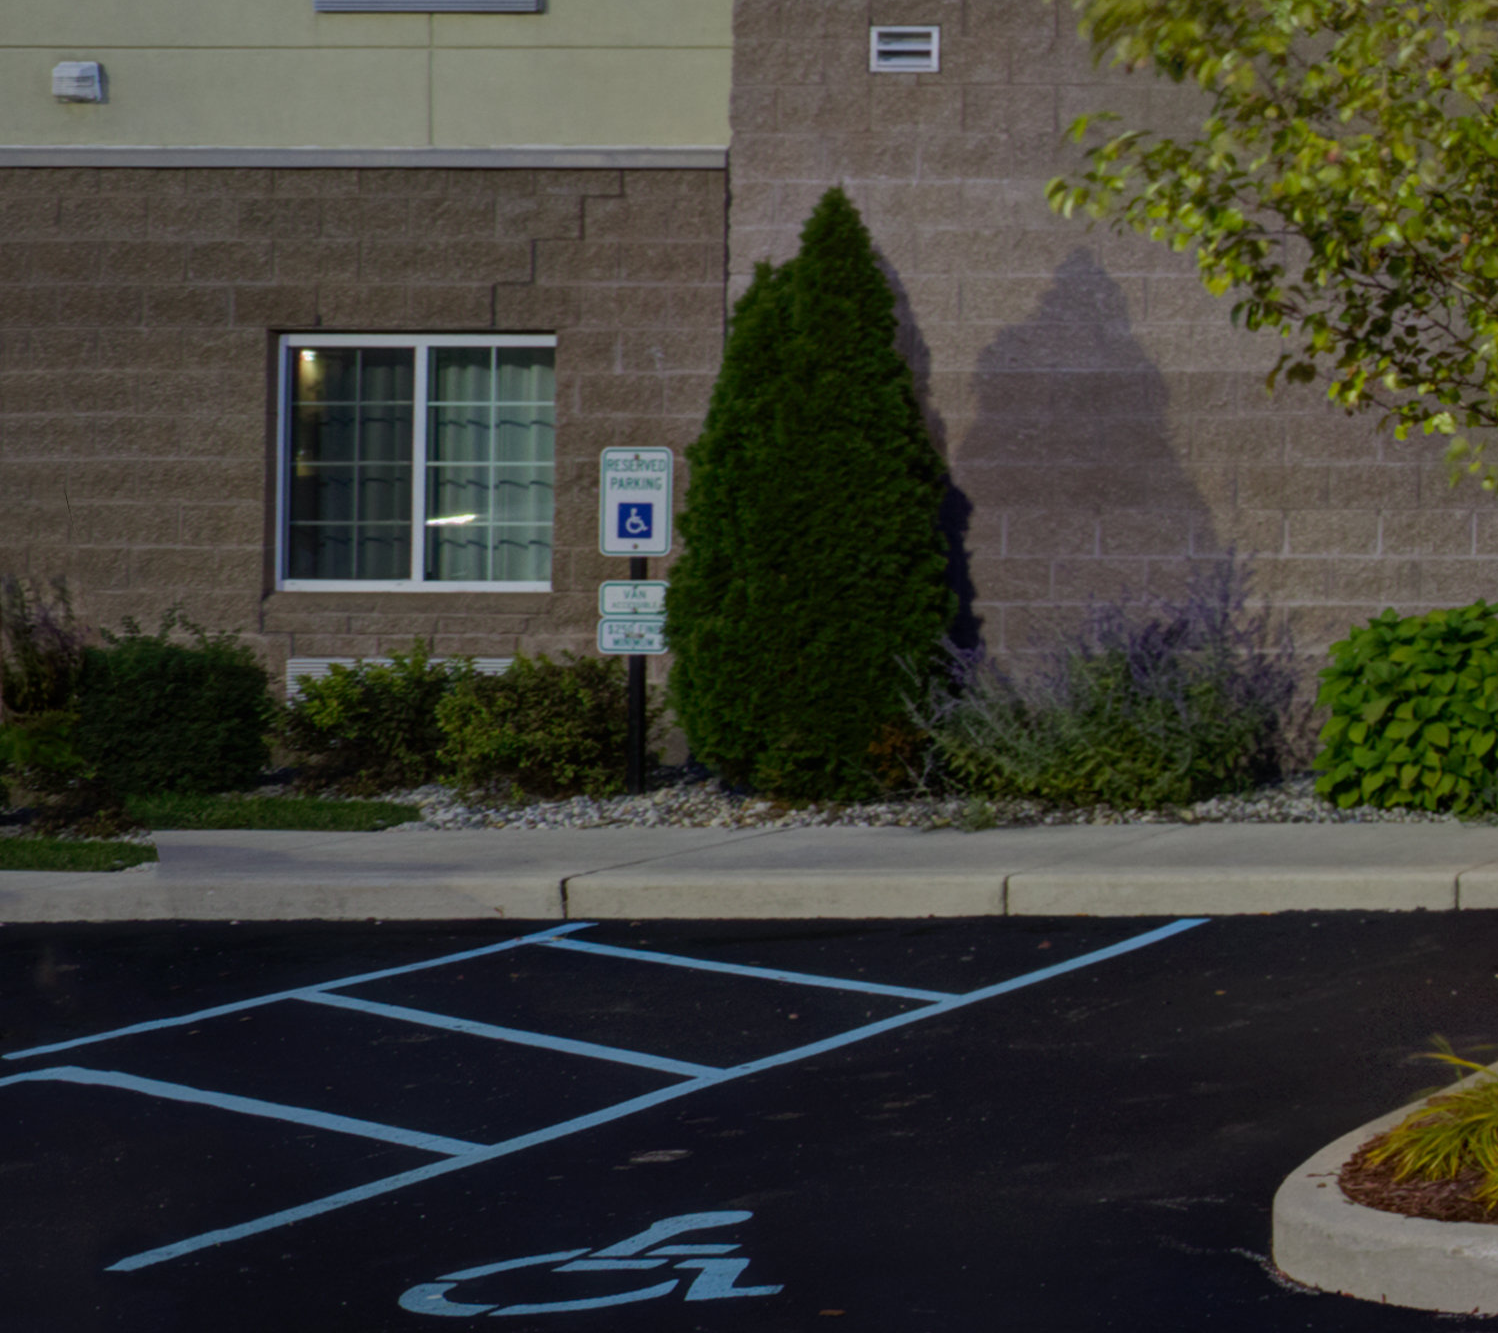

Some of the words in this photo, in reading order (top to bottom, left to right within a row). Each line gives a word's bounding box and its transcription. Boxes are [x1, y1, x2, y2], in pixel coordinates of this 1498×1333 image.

[606, 458, 666, 473] RESERVED
[611, 476, 663, 491] PARKING
[623, 589, 647, 600] VAN
